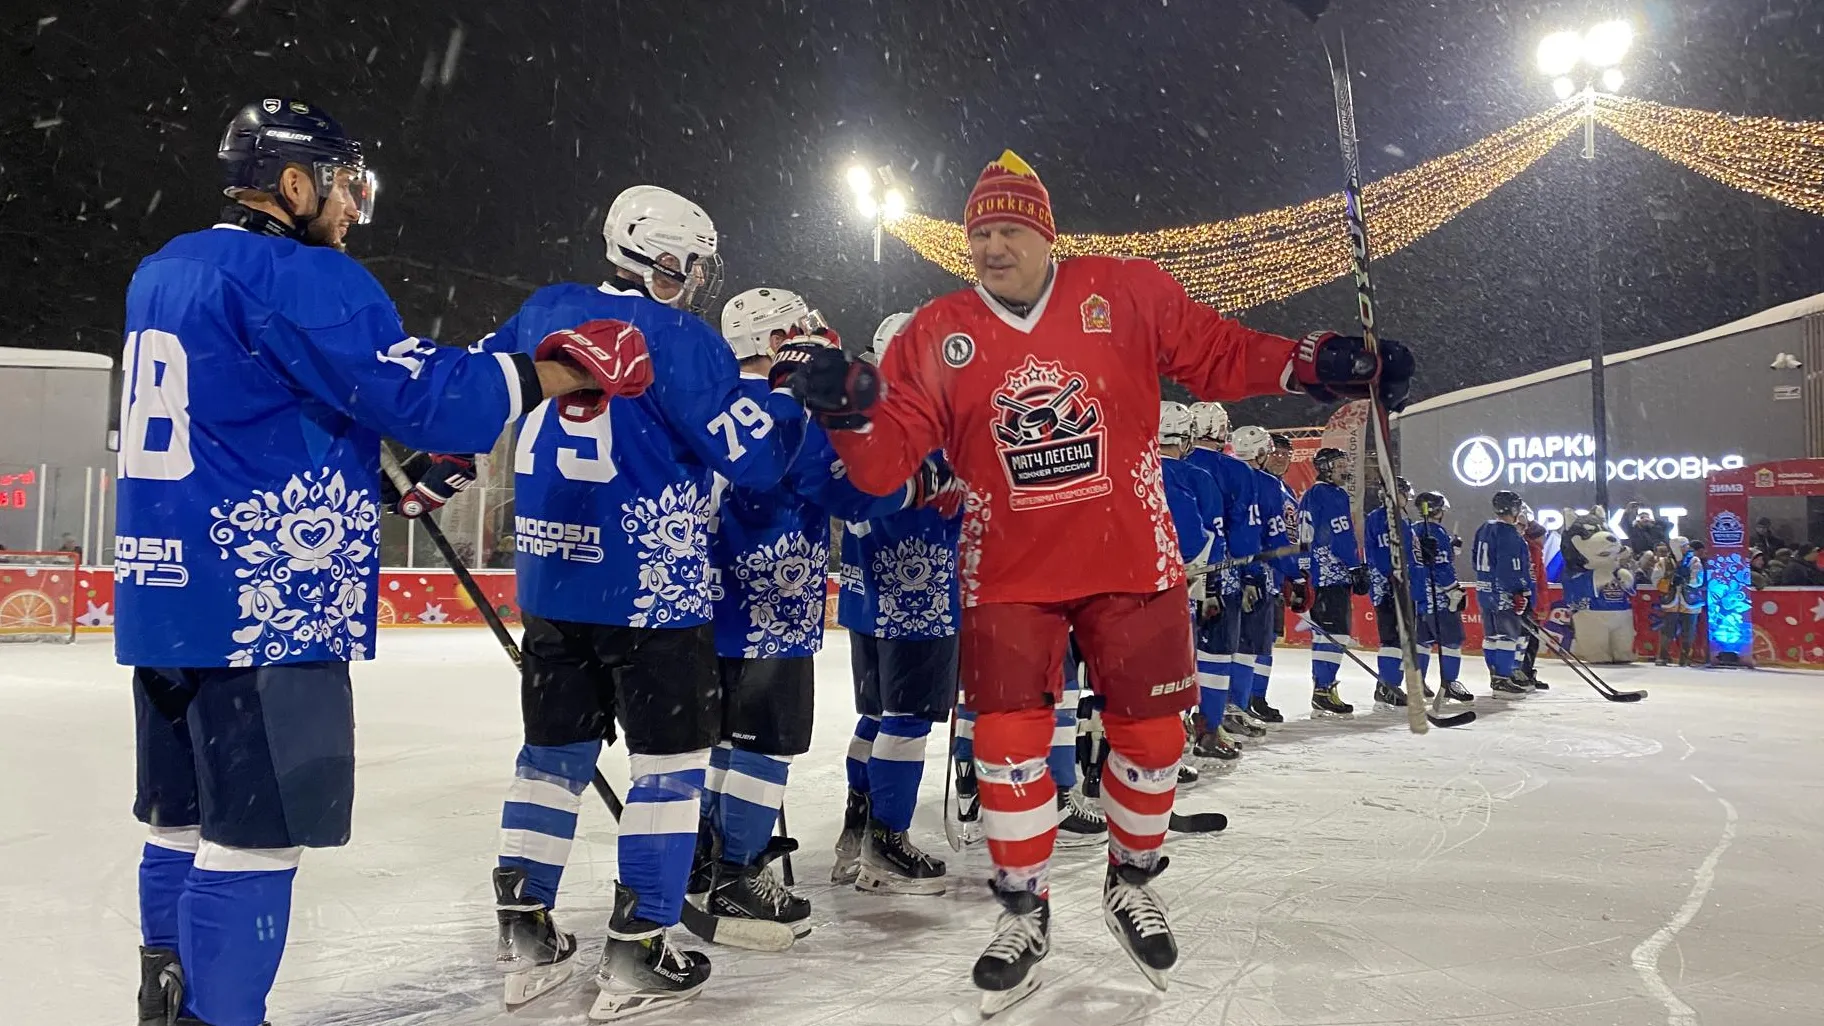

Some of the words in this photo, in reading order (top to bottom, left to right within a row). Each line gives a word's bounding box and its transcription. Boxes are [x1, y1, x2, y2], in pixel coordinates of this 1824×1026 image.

[265, 130, 313, 142] BAUER
[707, 396, 774, 463] 79
[1011, 452, 1043, 470] МАТЧ
[1044, 443, 1093, 466] ЛЕГЕНД
[1053, 461, 1091, 474] РОССИИ
[515, 515, 600, 545] МОСОБЛ
[1267, 515, 1287, 537] 33
[1330, 515, 1350, 535] 56
[516, 534, 576, 560] СПОРТ
[1477, 540, 1490, 572] 11
[1512, 558, 1521, 570] 11
[653, 966, 685, 984] BAUER
